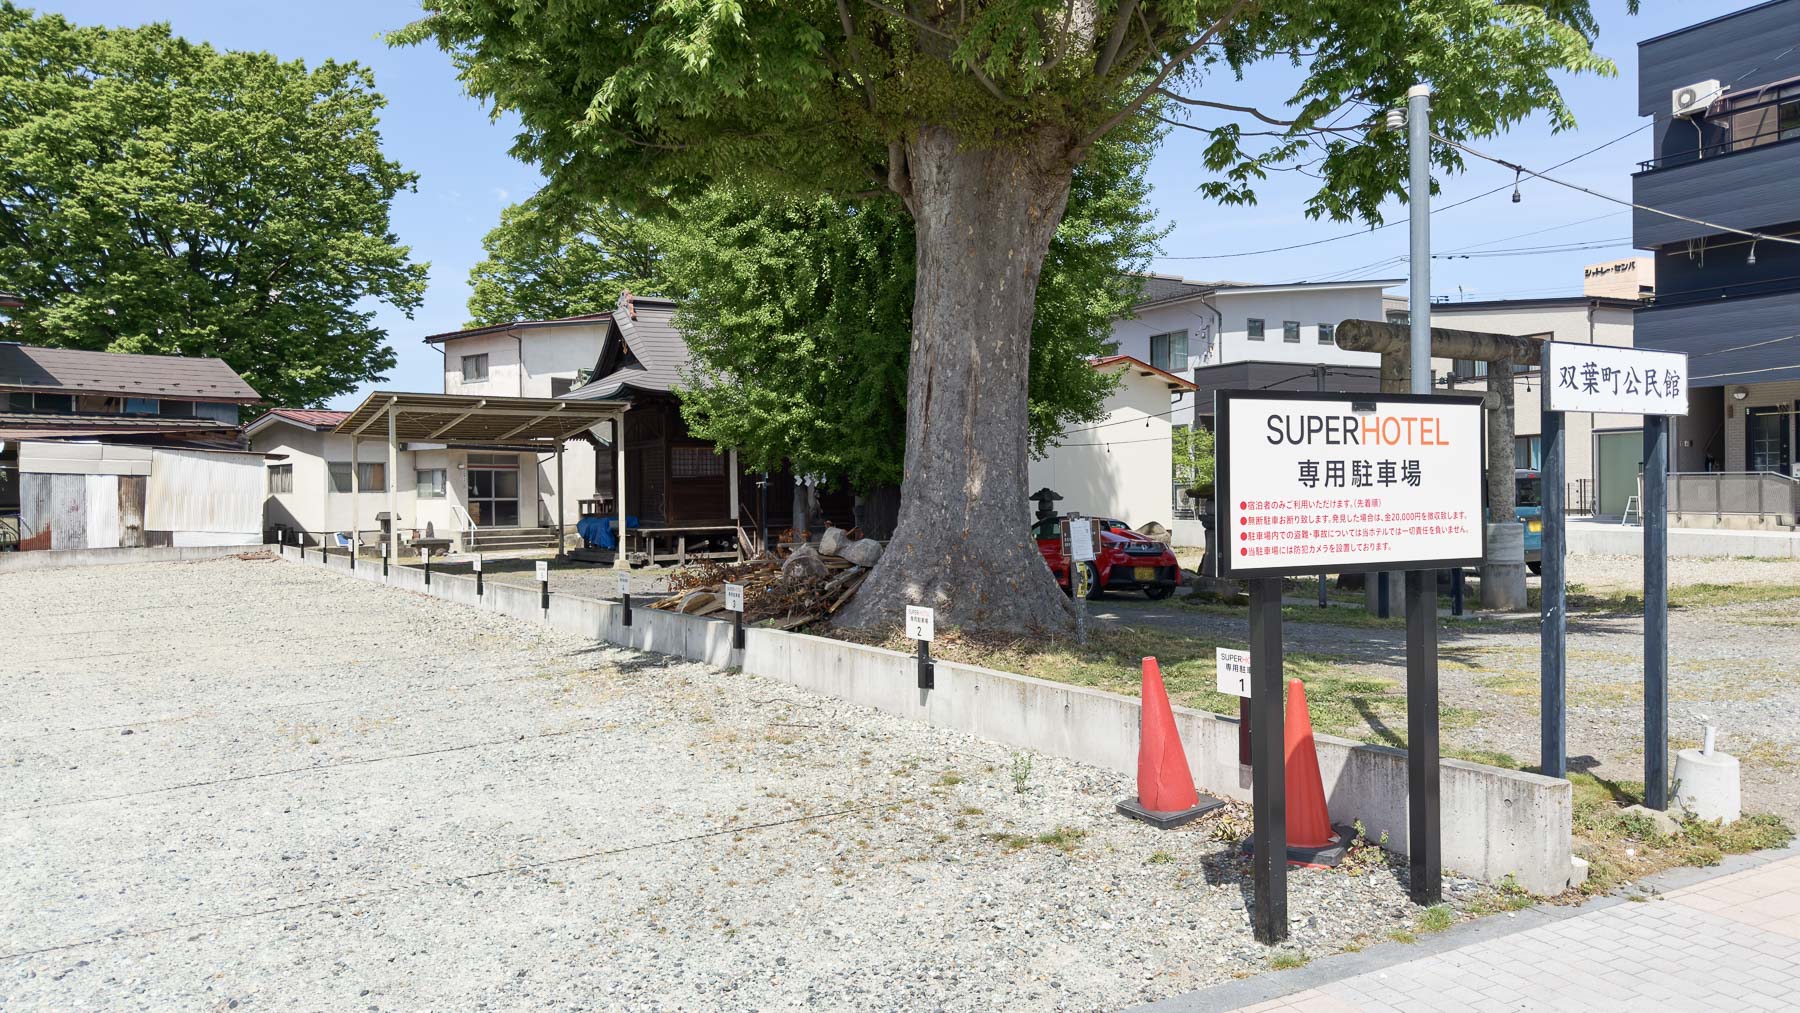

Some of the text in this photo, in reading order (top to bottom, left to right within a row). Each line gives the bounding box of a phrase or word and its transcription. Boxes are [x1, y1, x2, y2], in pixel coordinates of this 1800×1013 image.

[1559, 361, 1681, 399] 双葉町公民館
[1298, 459, 1422, 488] 専用駐車場
[917, 626, 922, 637] 2
[1239, 678, 1245, 692] 1
